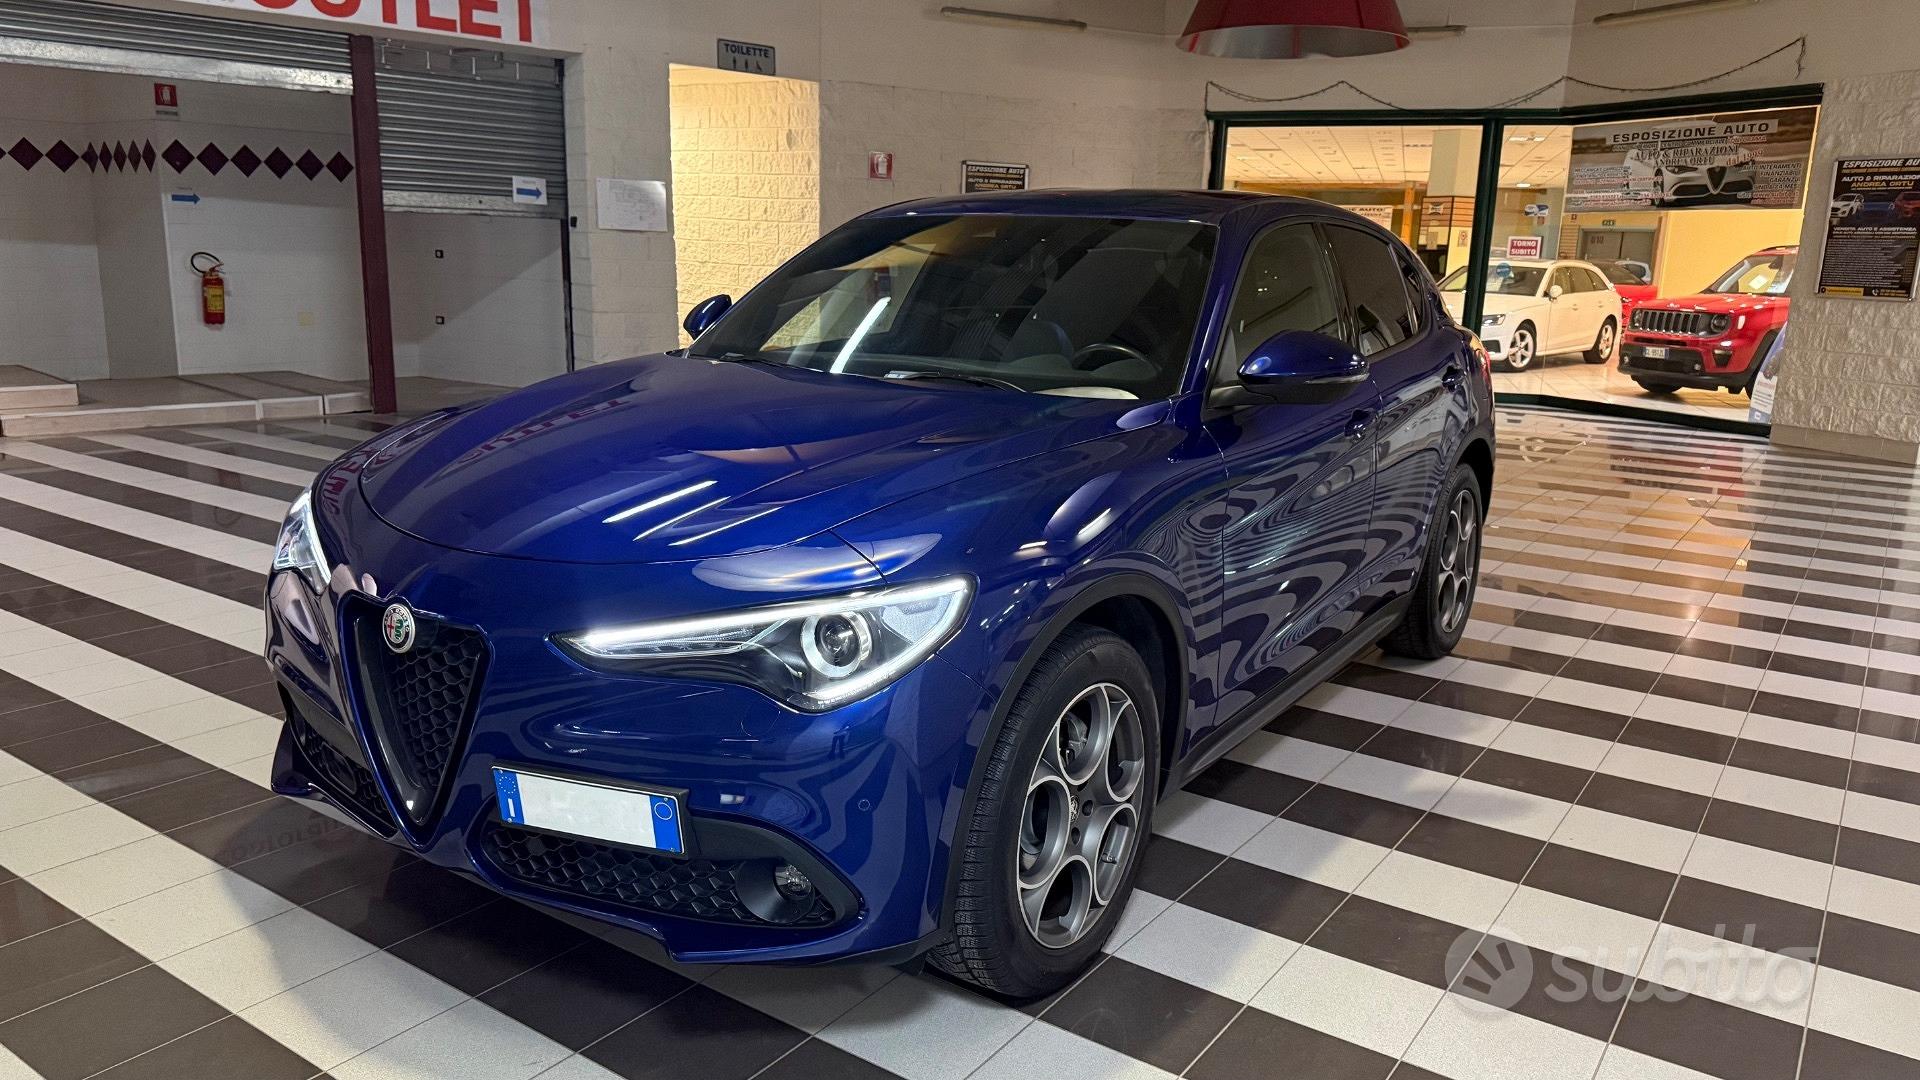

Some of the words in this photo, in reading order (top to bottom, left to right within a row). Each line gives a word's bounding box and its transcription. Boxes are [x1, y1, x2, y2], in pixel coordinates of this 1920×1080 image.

[723, 43, 770, 58] TOILETTE
[1613, 126, 1717, 143] ESPOSIZIONE
[1723, 122, 1770, 135] AUTO
[1843, 159, 1904, 168] ESPOSIZIONE
[1905, 158, 1920, 167] AU
